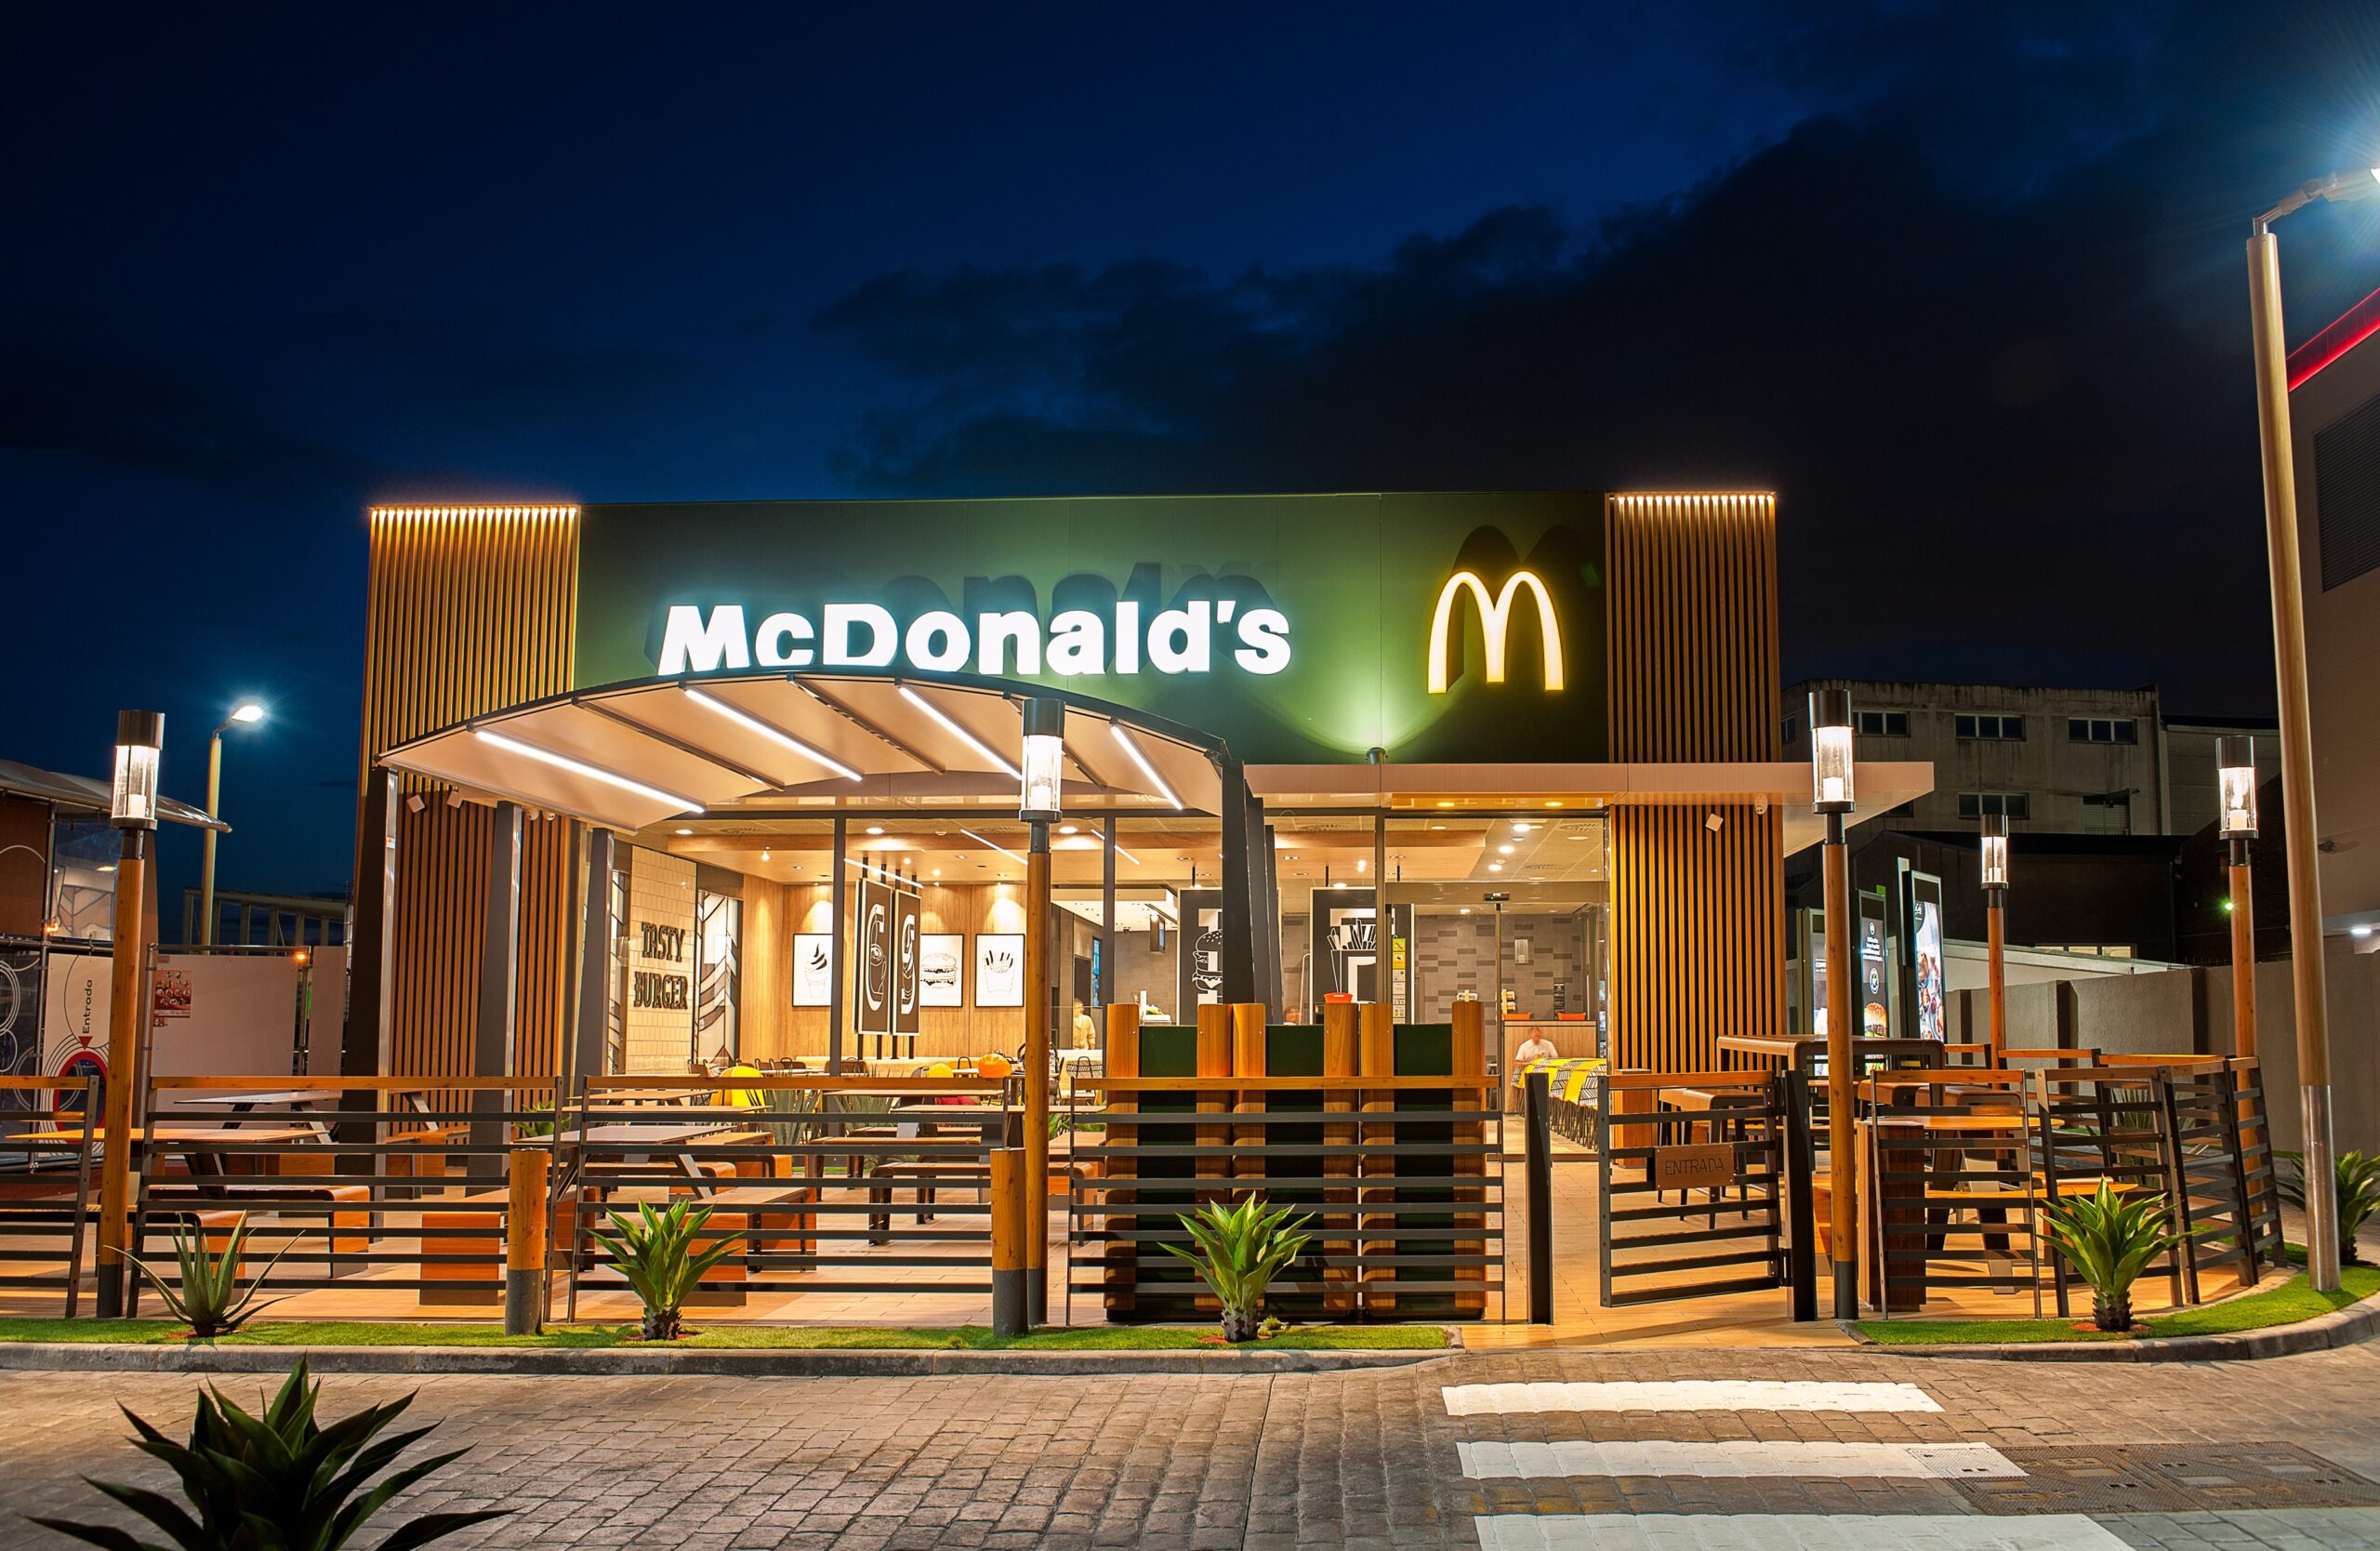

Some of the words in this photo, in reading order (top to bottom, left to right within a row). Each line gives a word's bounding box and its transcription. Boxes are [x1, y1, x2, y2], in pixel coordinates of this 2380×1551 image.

[657, 601, 1292, 676] McDonald's
[641, 921, 686, 963] TASTY
[82, 979, 93, 1034] Entrada
[633, 971, 689, 1011] BURGER
[1664, 1157, 1726, 1176] ENTRADA
